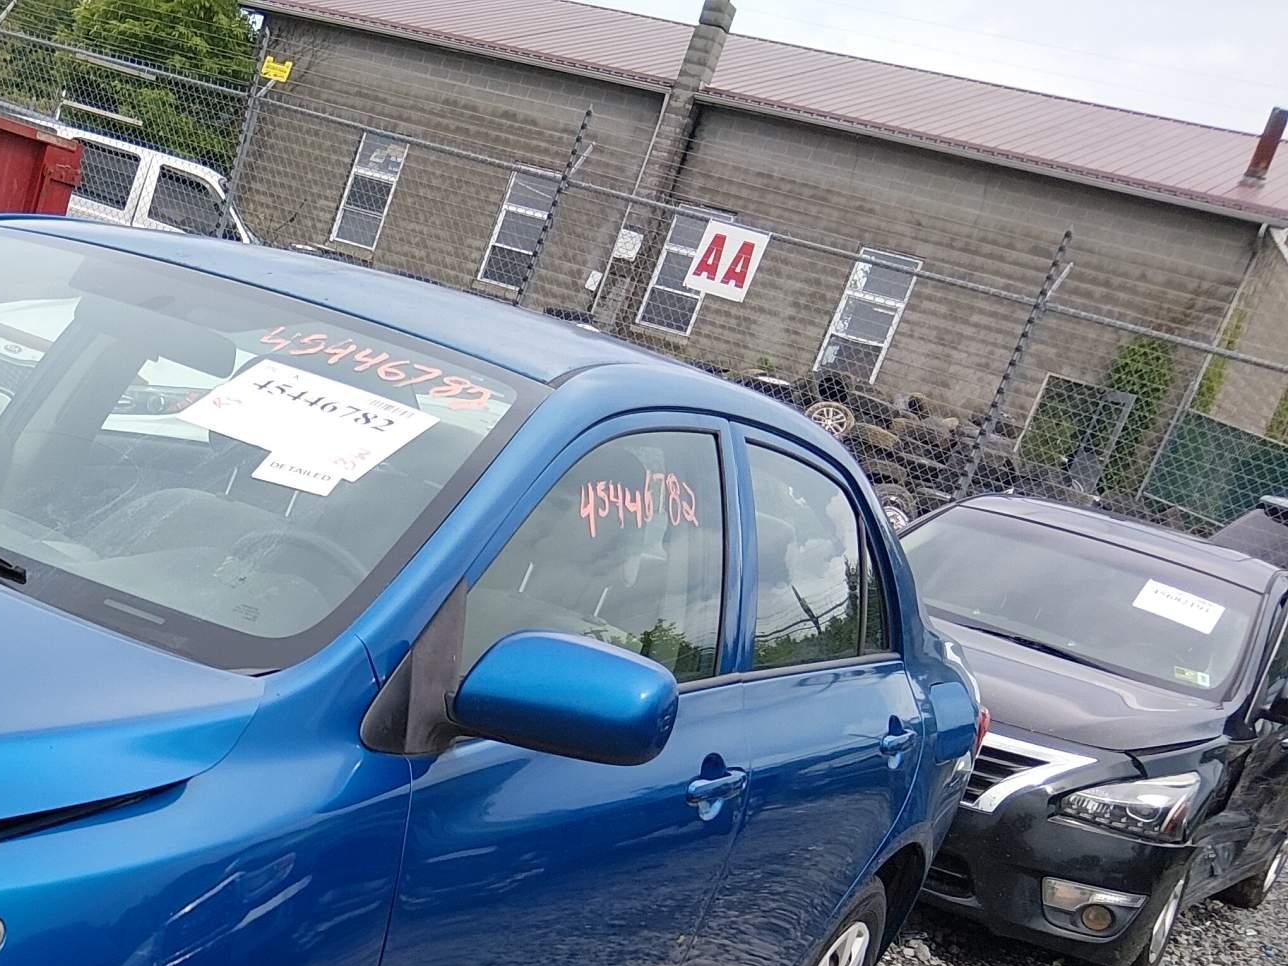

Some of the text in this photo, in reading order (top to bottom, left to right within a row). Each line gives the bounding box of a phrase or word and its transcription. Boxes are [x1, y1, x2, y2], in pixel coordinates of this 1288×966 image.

[692, 233, 755, 288] AA
[252, 379, 395, 432] 45446782
[269, 460, 332, 482] DETAILED
[580, 470, 699, 538] 45446782
